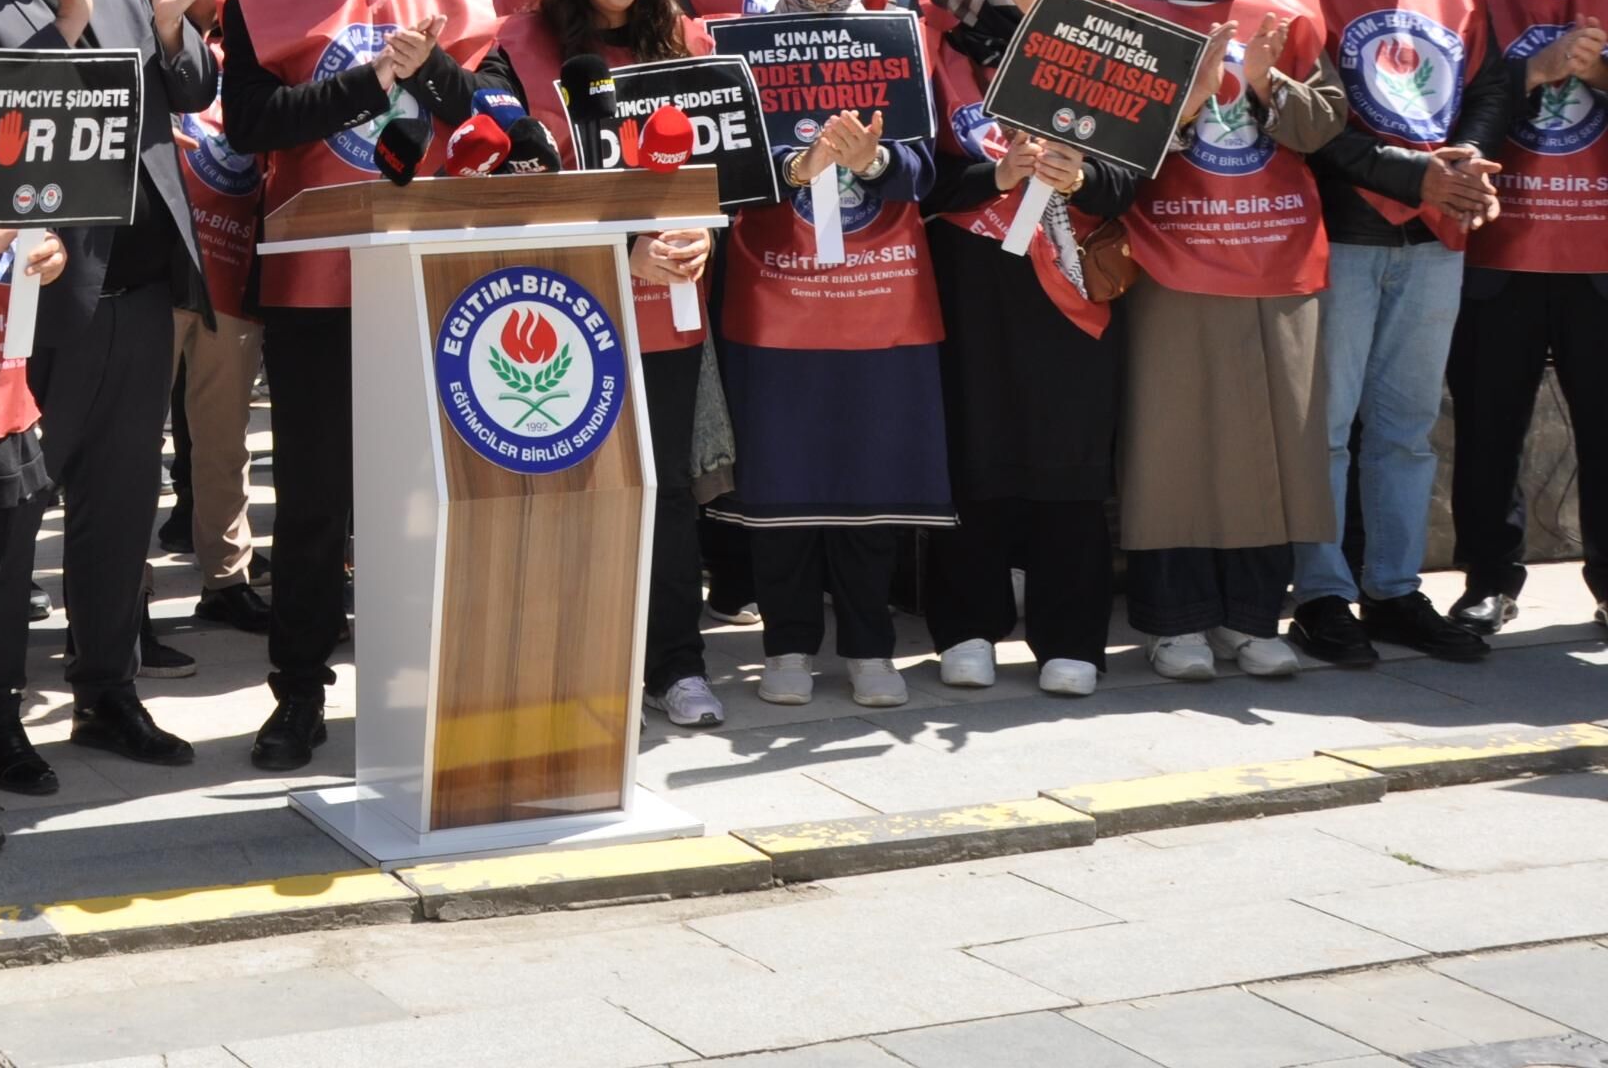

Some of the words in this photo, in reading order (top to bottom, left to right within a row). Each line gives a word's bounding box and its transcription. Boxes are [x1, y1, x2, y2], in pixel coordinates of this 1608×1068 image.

[774, 29, 851, 47] KINAMA
[1054, 22, 1114, 56] MESAJI
[1114, 46, 1159, 73] DEĞİL
[1083, 14, 1143, 48] KINAMA
[749, 48, 818, 64] MESAJI
[824, 41, 881, 59] DEĞİL
[819, 58, 910, 84] YASASI
[1023, 31, 1101, 76] ŞİDDET
[1102, 58, 1178, 106] YASASI
[65, 89, 130, 110] ŞİDDETE
[1031, 62, 1148, 123] İSTİYORUZ
[69, 116, 128, 162] DE
[444, 274, 615, 356] EĞİTİM-BİR-SEN
[450, 381, 519, 459] EĞİTİMCİLER
[522, 440, 574, 462] BİRLİĞİ
[573, 375, 615, 449] SENDİKASI
[525, 422, 548, 432] 1992
